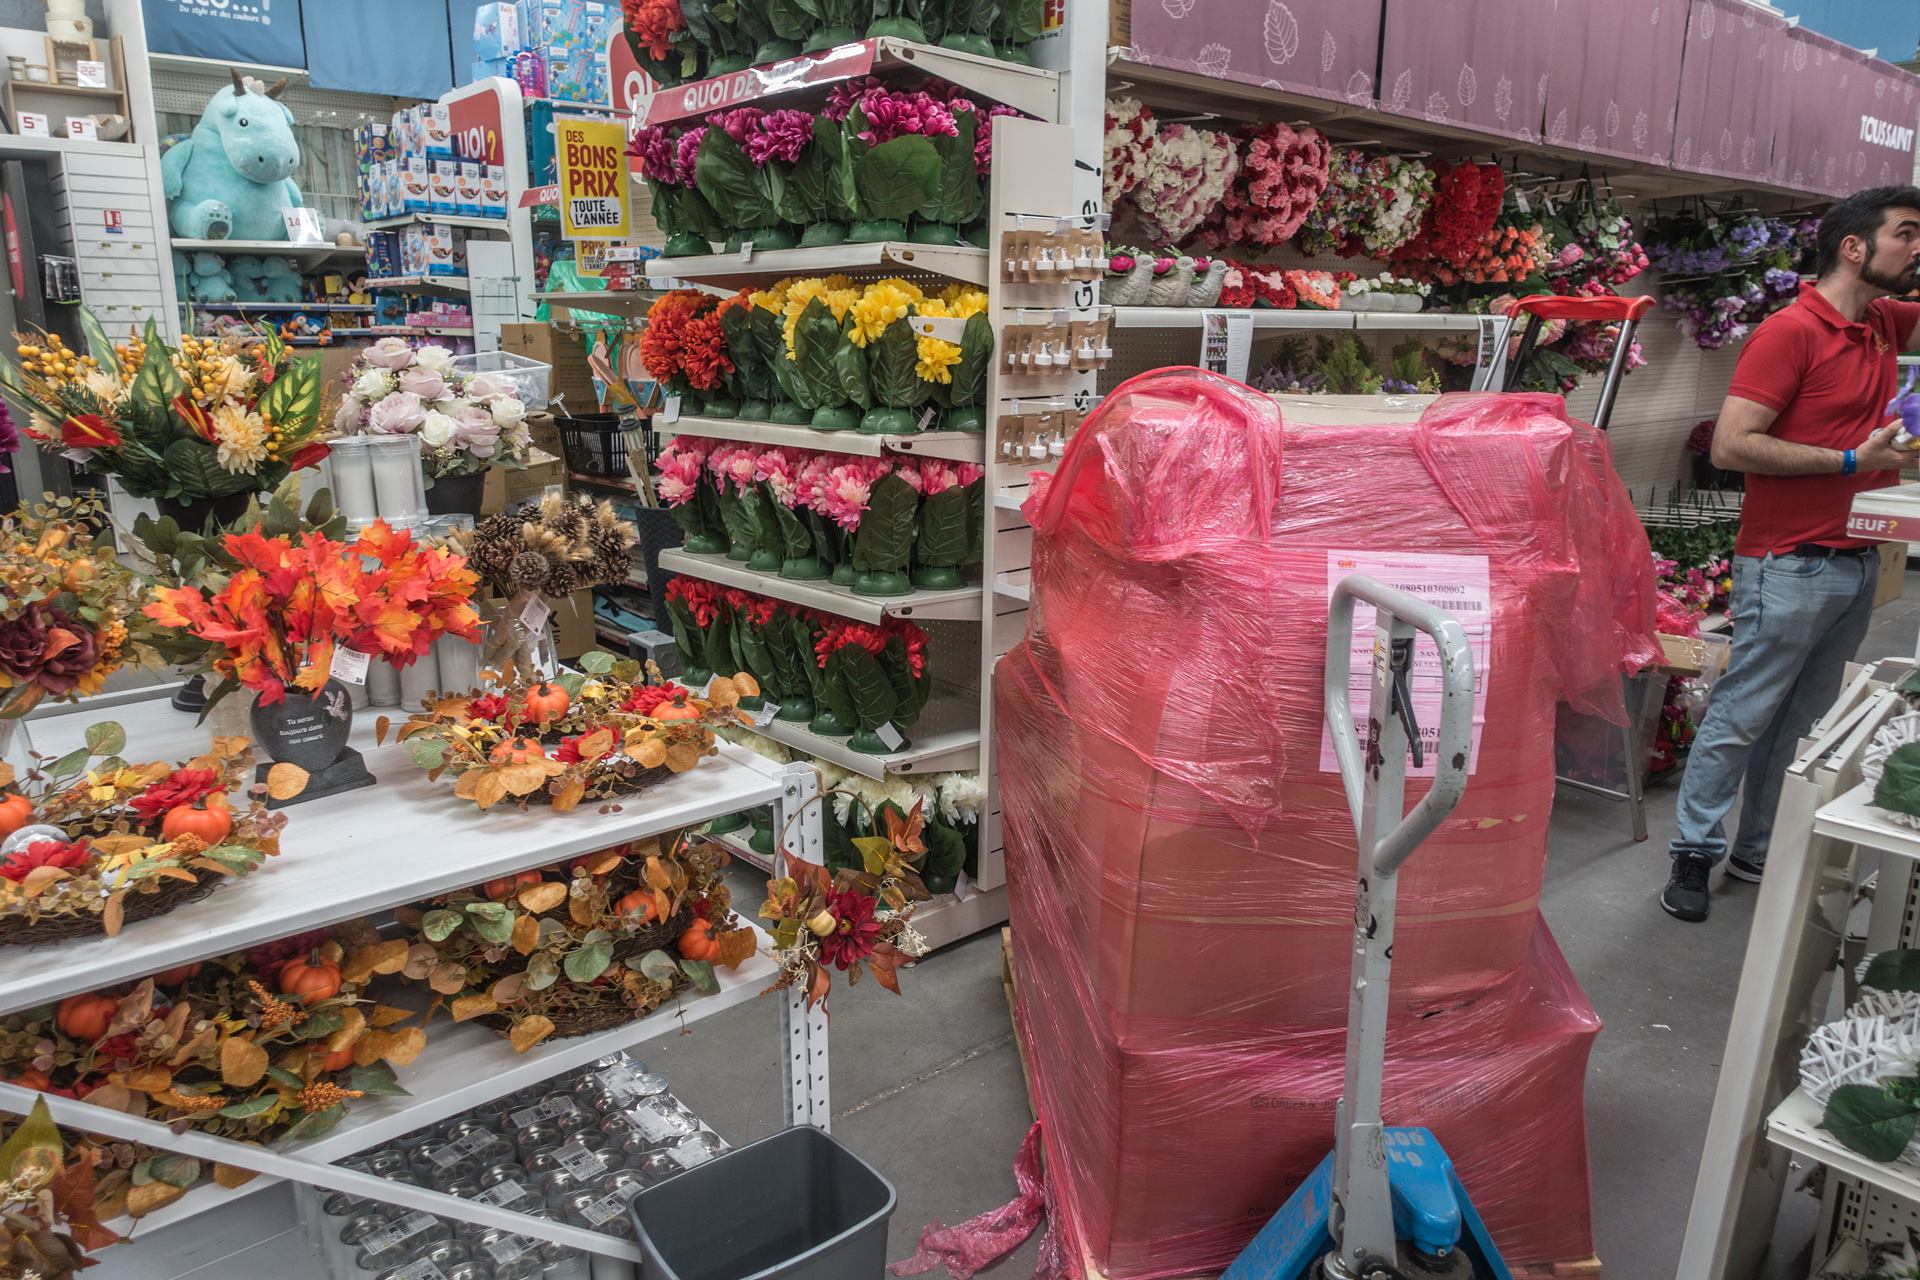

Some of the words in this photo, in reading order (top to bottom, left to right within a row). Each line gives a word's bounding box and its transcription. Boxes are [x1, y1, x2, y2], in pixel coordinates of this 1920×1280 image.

[179, 4, 190, 12] Du
[192, 6, 208, 16] style
[220, 10, 231, 18] des
[233, 13, 259, 22] couleurs
[80, 66, 97, 76] 22
[684, 78, 729, 112] QUOI
[23, 116, 35, 129] 5
[72, 121, 83, 134] 9
[458, 125, 496, 161] UOI?
[565, 130, 584, 143] DES
[567, 144, 618, 170] BONS
[568, 169, 619, 198] PRIX
[540, 188, 560, 202] QUO
[573, 200, 605, 213] TOUTE
[574, 210, 619, 226] L'ANNÉE
[1390, 584, 1465, 594] 1080510300002
[297, 716, 314, 724] seras
[280, 727, 308, 736] toujours
